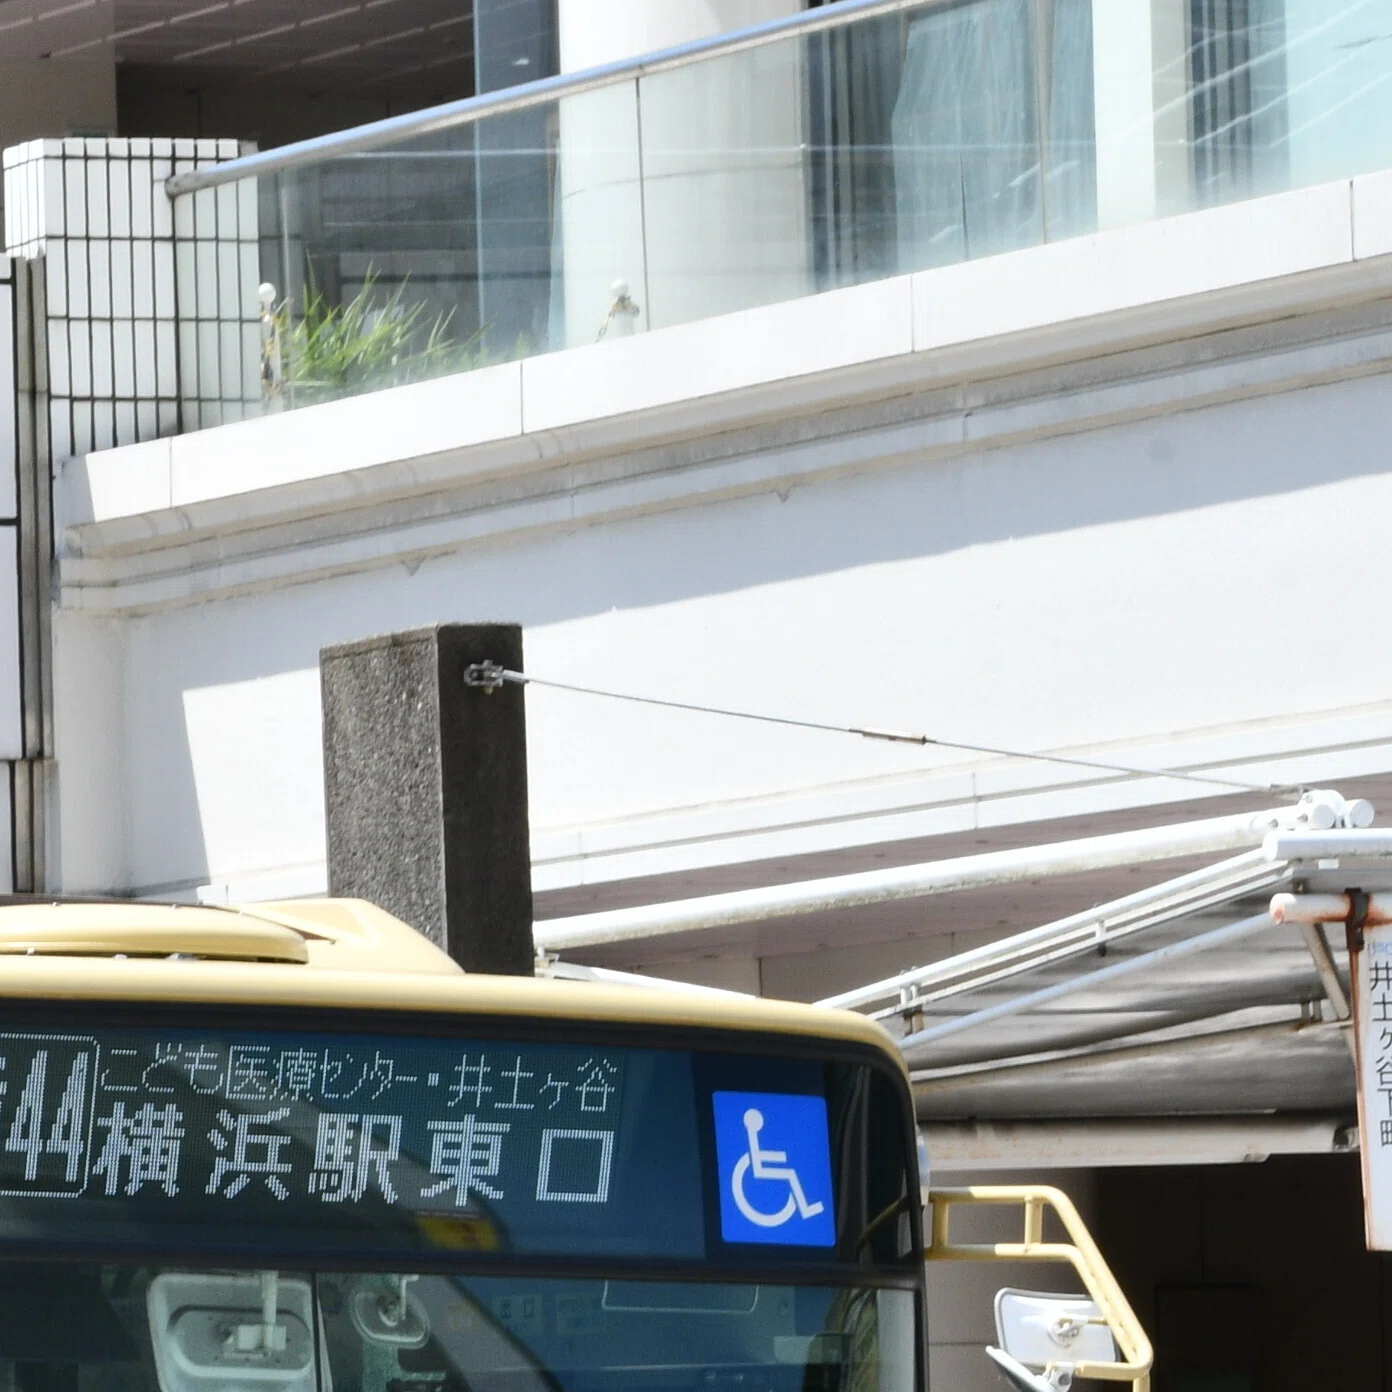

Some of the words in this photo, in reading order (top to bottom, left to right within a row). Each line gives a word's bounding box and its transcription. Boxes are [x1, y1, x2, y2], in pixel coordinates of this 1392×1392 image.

[91, 1100, 616, 1208] 横浜駅東口
